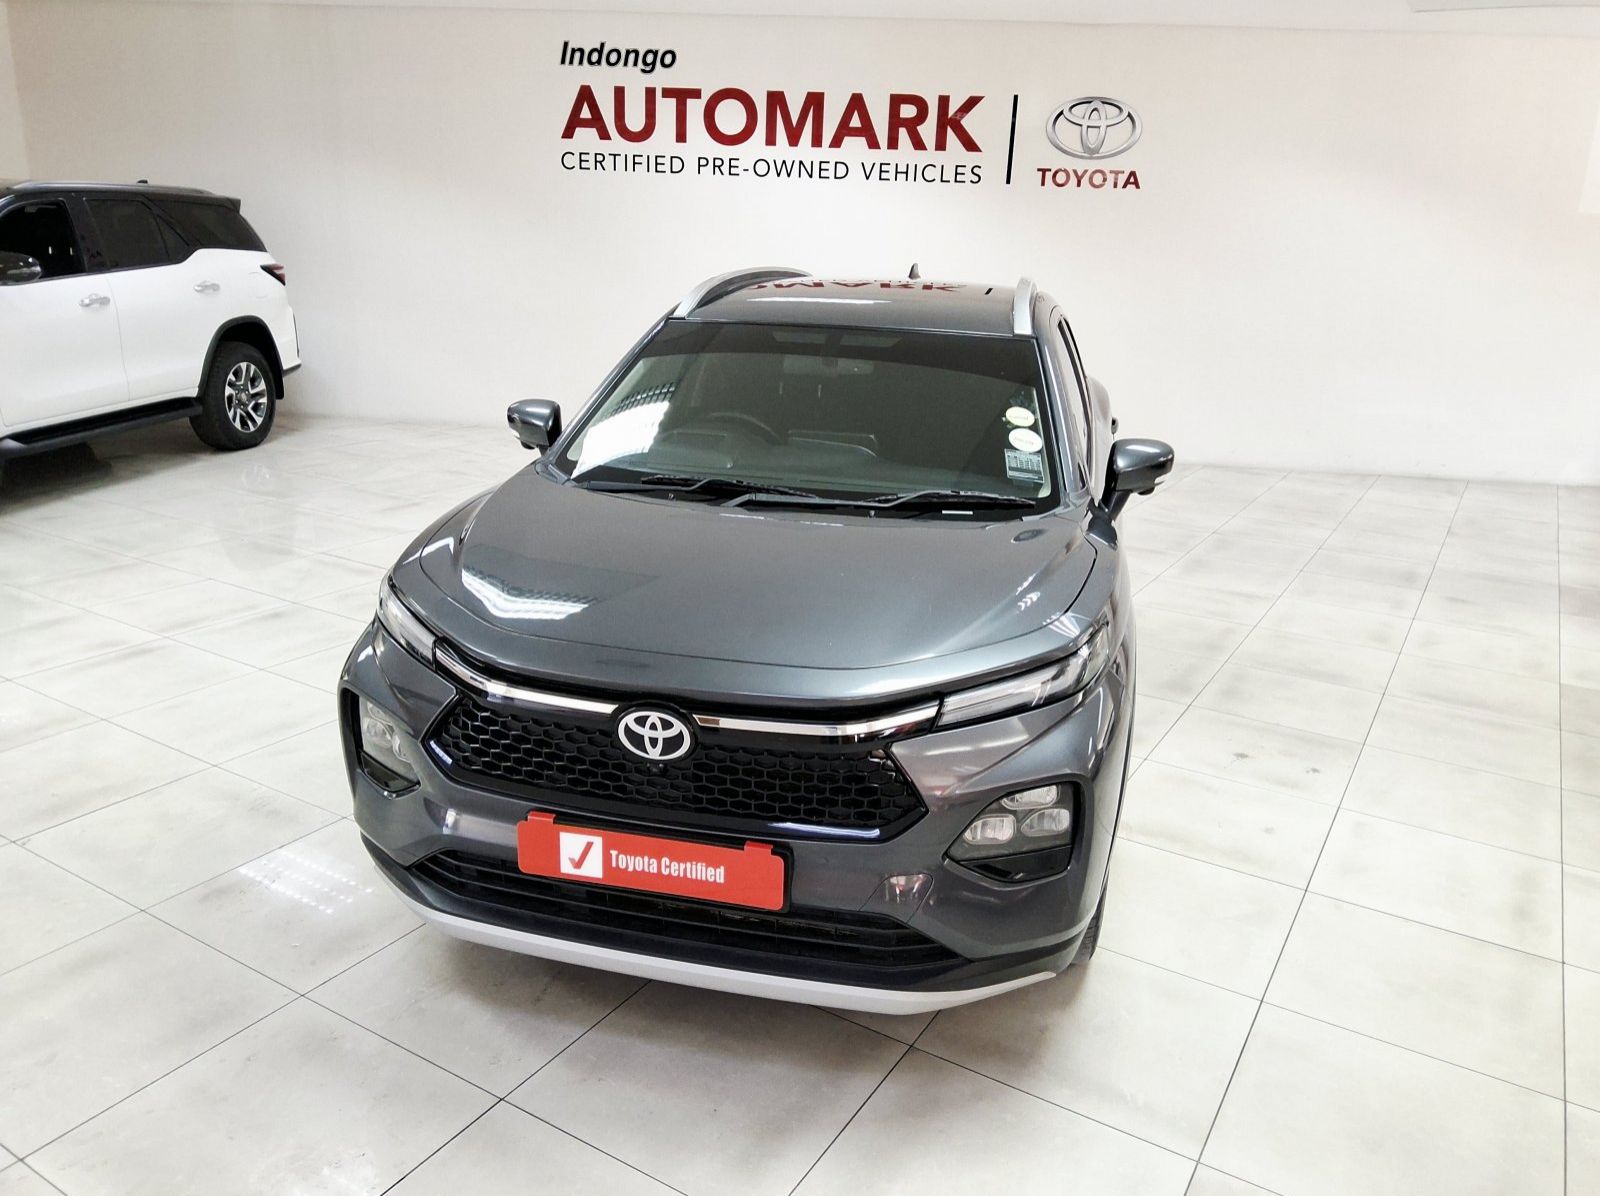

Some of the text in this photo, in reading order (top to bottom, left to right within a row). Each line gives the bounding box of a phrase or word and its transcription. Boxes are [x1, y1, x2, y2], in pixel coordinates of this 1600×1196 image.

[559, 41, 677, 74] Indongo
[561, 84, 986, 152] AUTOMARK
[560, 151, 982, 184] CERTIFIED PRE-OWNED VEHICLES
[1038, 167, 1141, 190] TOYOTA
[610, 849, 725, 884] Toyota Certified
